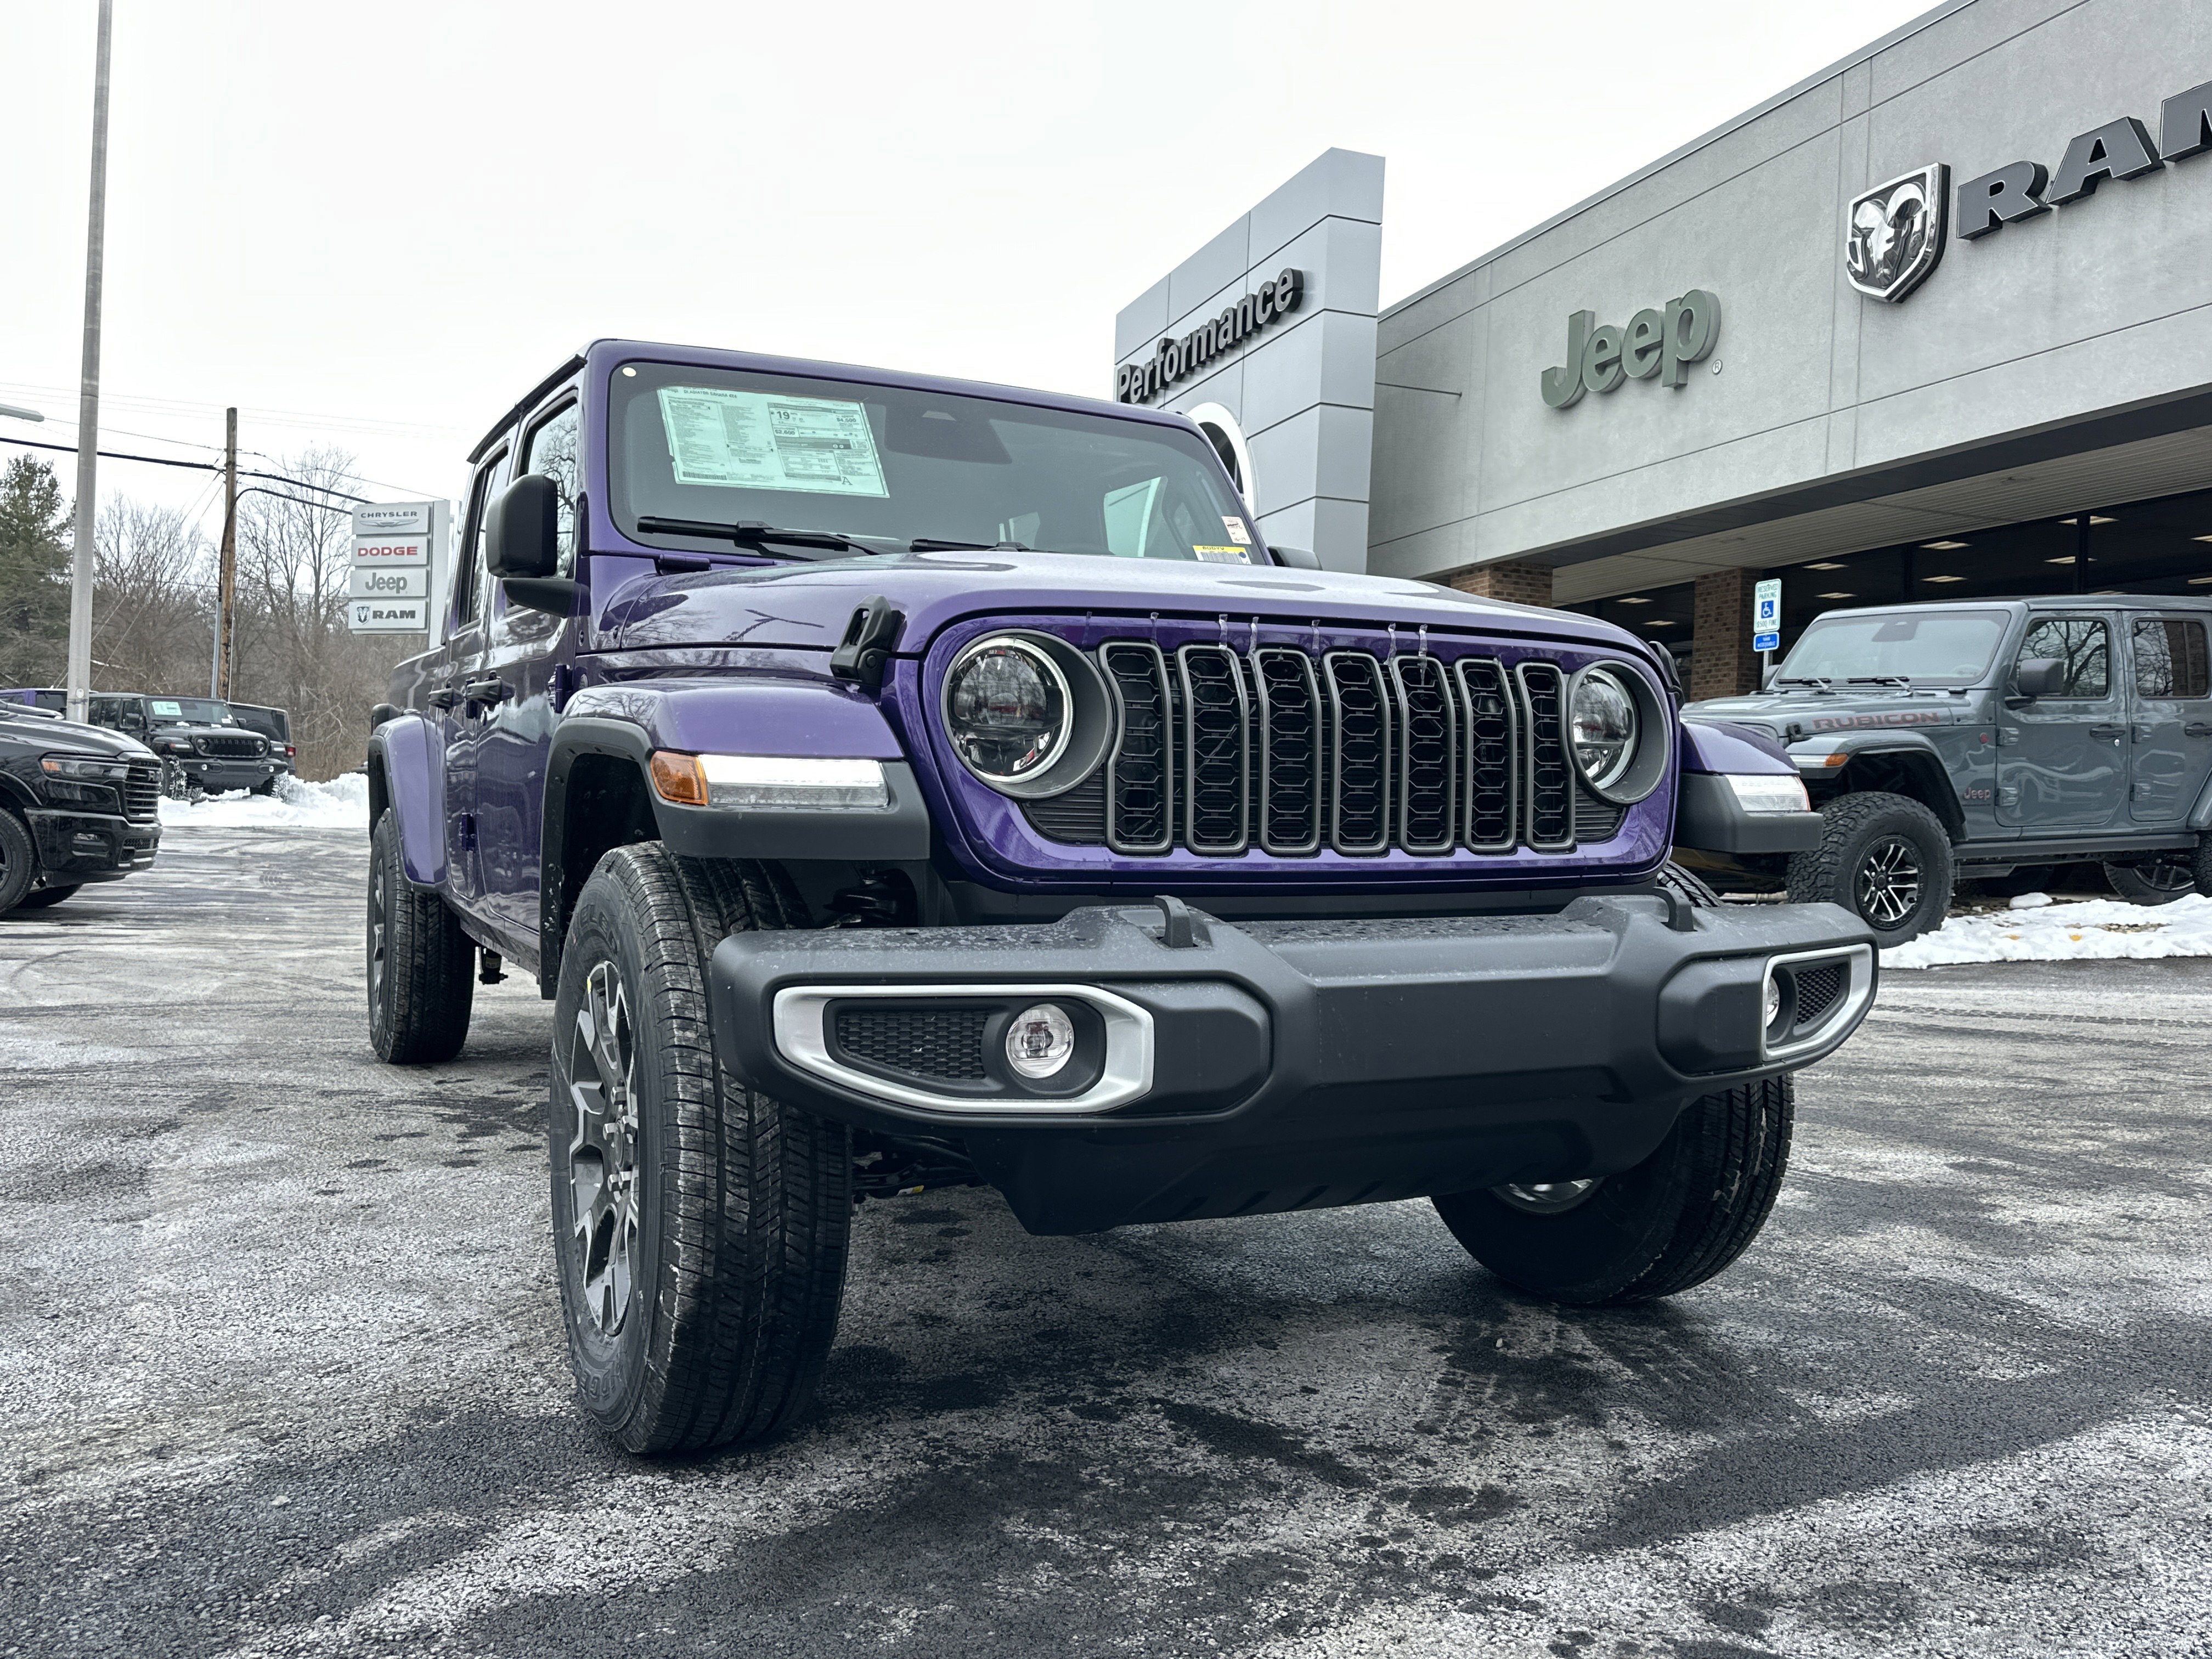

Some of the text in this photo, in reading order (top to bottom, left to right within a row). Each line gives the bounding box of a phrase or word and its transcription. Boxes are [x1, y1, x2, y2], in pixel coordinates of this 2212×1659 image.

[1117, 267, 1304, 403] Performance
[1541, 289, 1722, 408] Jeep
[776, 411, 790, 420] 19
[358, 546, 418, 556] DODGE
[365, 572, 408, 594] Jeep
[1758, 583, 1778, 593] RESERVED
[372, 610, 416, 619] RAM
[1813, 713, 1940, 729] RUBICON
[1964, 787, 1990, 800] Jeep
